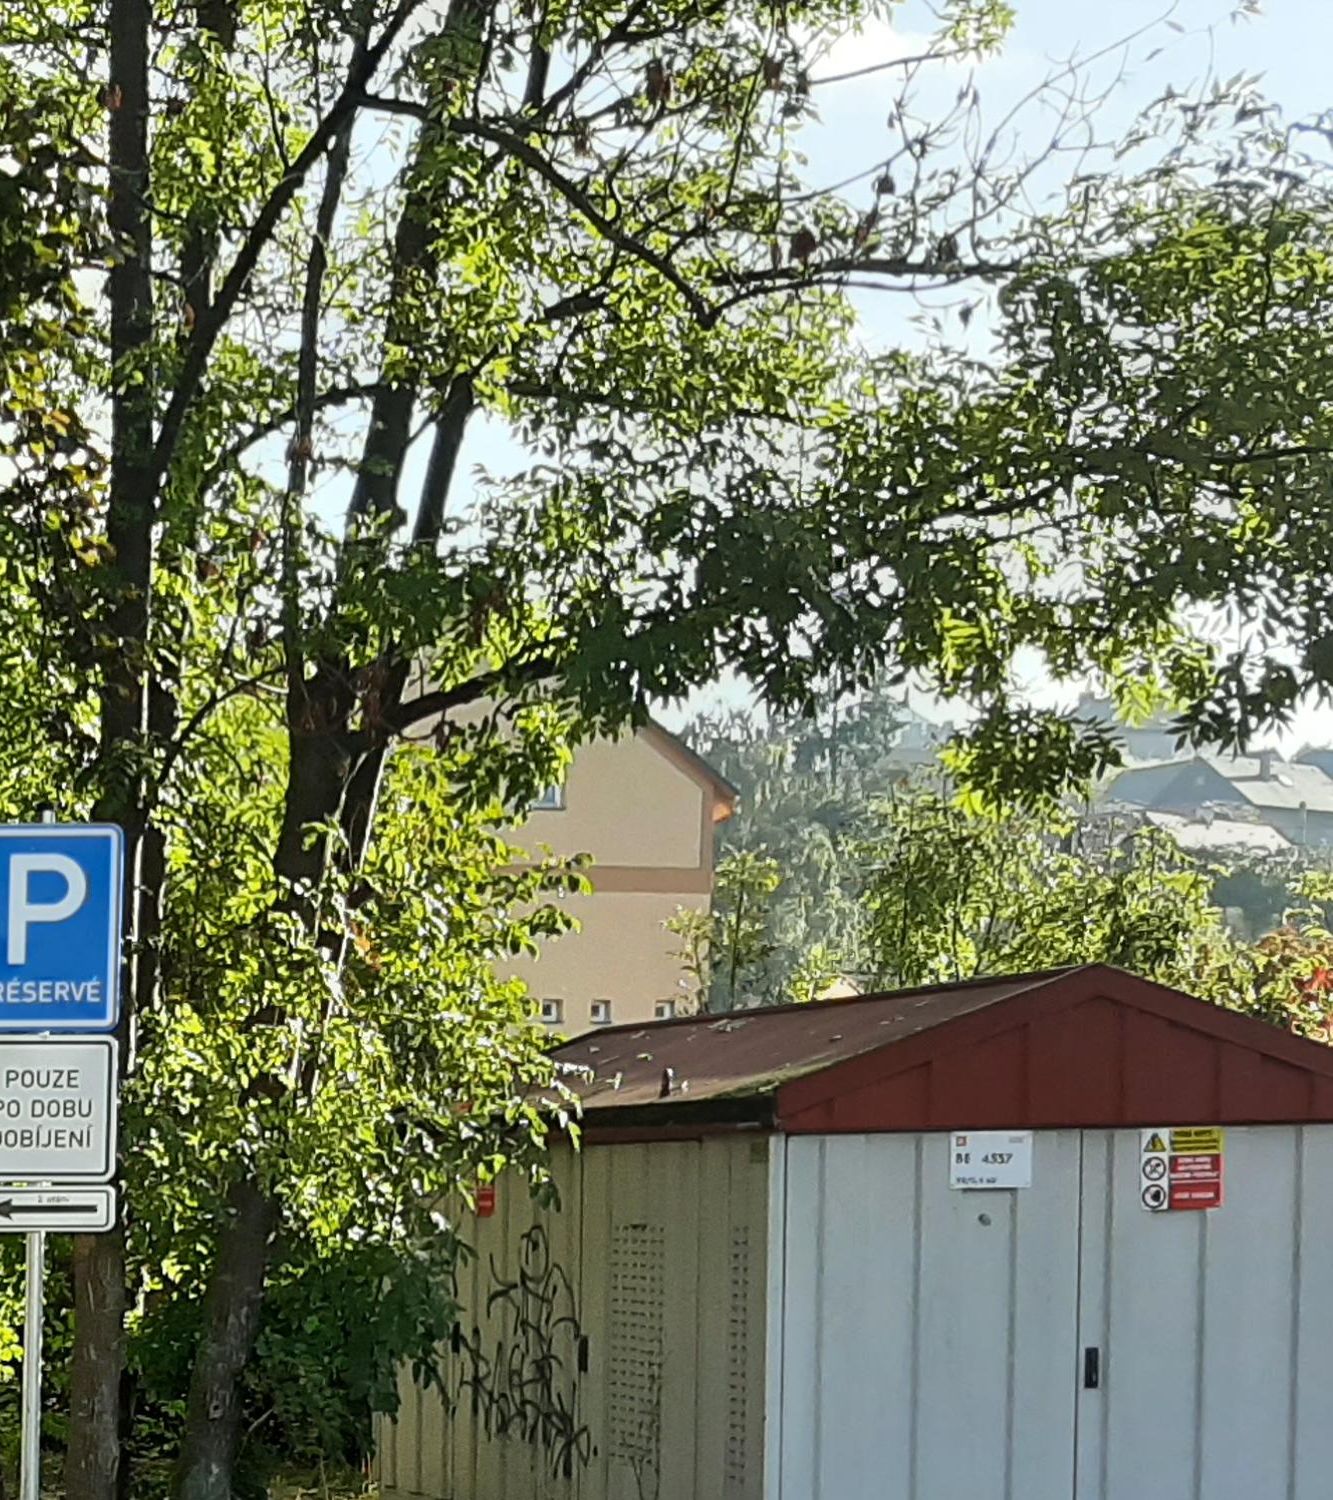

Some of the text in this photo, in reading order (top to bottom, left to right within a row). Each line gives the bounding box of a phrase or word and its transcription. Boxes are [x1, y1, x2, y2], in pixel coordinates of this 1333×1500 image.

[7, 853, 87, 966] P
[5, 1069, 80, 1089] POUZE
[31, 1098, 92, 1118] DOBU
